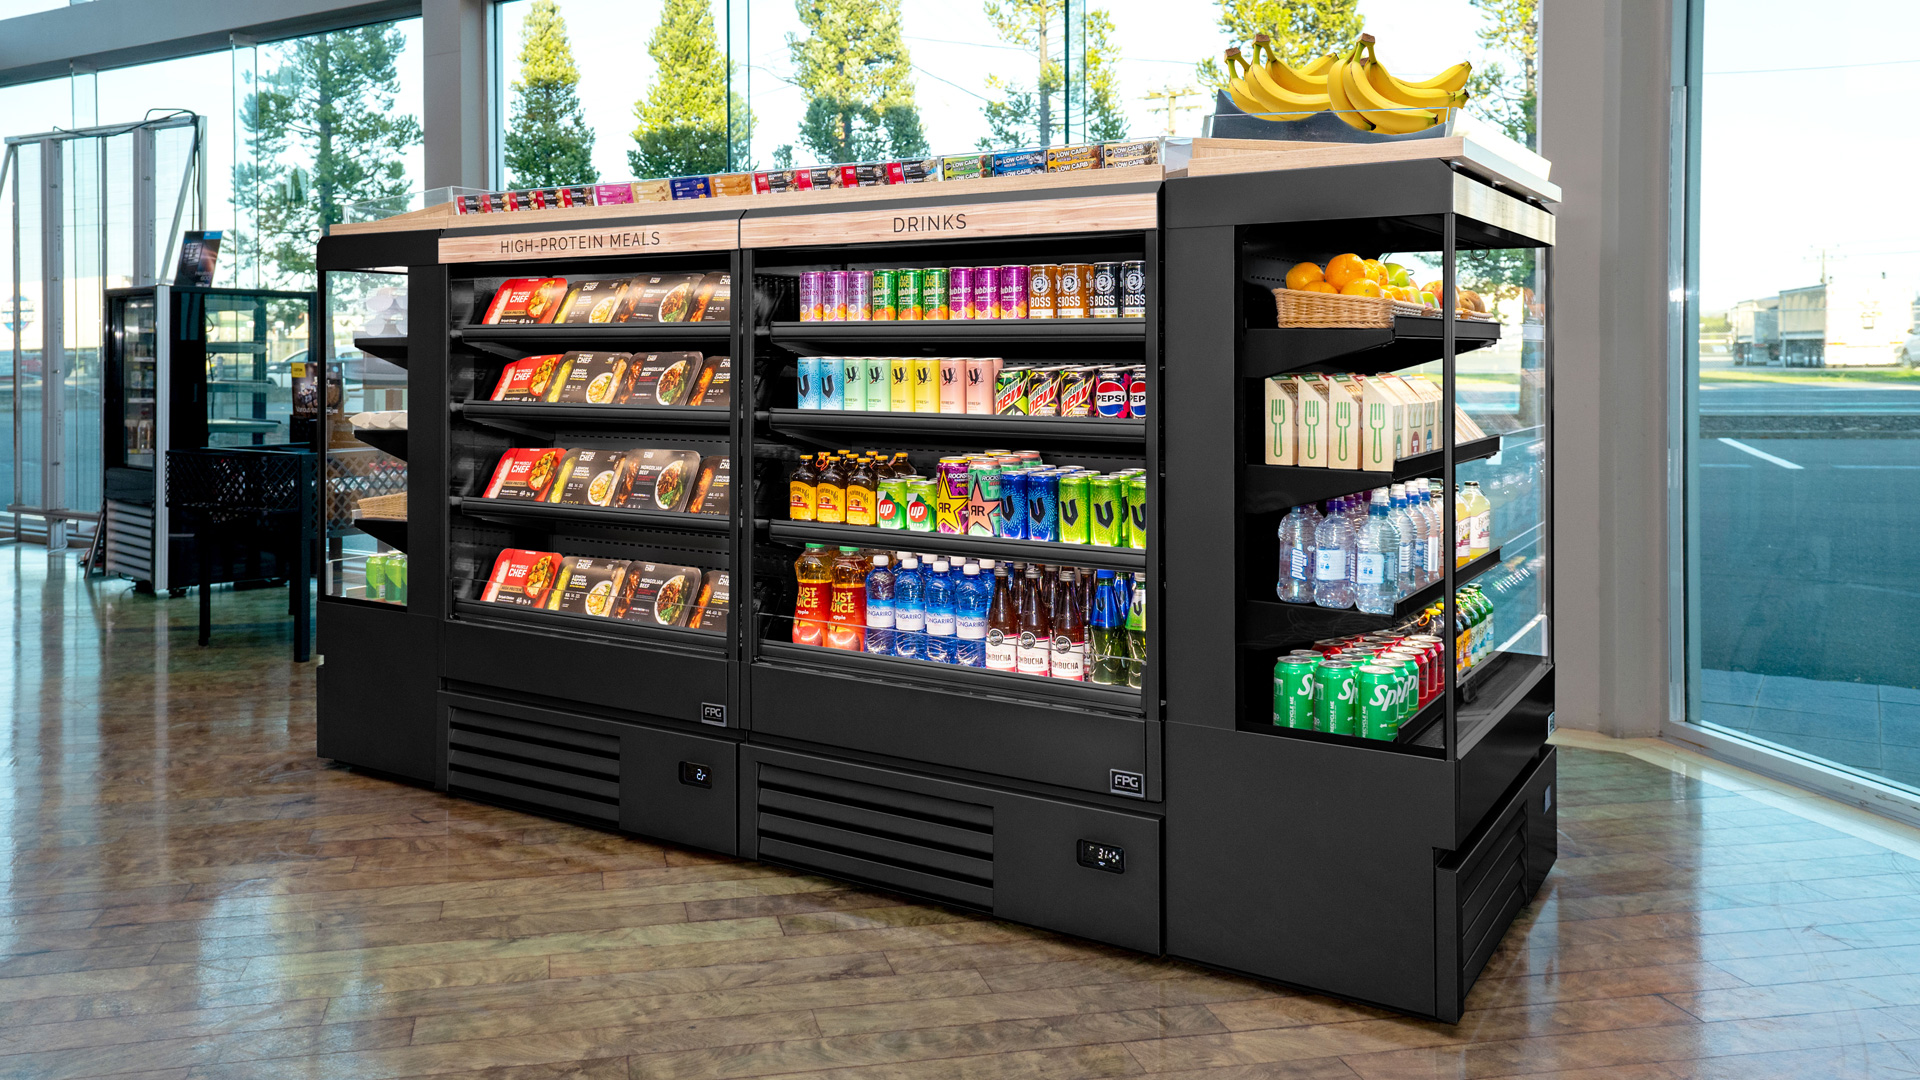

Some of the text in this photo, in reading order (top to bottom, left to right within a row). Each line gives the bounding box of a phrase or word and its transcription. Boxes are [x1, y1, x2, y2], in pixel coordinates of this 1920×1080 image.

[1070, 147, 1088, 155] CARB
[964, 158, 979, 166] CARB
[1071, 161, 1089, 169] CARB
[893, 213, 967, 233] DRINKS
[500, 231, 661, 254] HIGH-PROTEIN MEALS
[950, 286, 971, 295] ubbles
[975, 286, 997, 295] ubbles
[1001, 285, 1023, 294] ubbles
[510, 295, 530, 303] CHEF
[1031, 296, 1051, 307] BOSS
[1095, 295, 1115, 307] BOSS
[1126, 294, 1145, 306] BOSS
[513, 373, 532, 381] CHEF
[1096, 394, 1126, 403] PEPSI
[1130, 395, 1146, 403] PEP
[511, 465, 530, 474] CHEF
[576, 562, 591, 570] CHEF
[1291, 548, 1306, 580] pump
[508, 568, 527, 578] CHEF
[797, 597, 819, 608] UICE
[831, 601, 855, 613] UICE
[867, 609, 892, 617] ONGARIRO
[986, 652, 1011, 661] OMBUCHA
[1018, 655, 1043, 665] OMBUCHA
[1052, 660, 1079, 670] OMBUCHA
[704, 706, 722, 718] FPG
[1114, 774, 1138, 788] FPG
